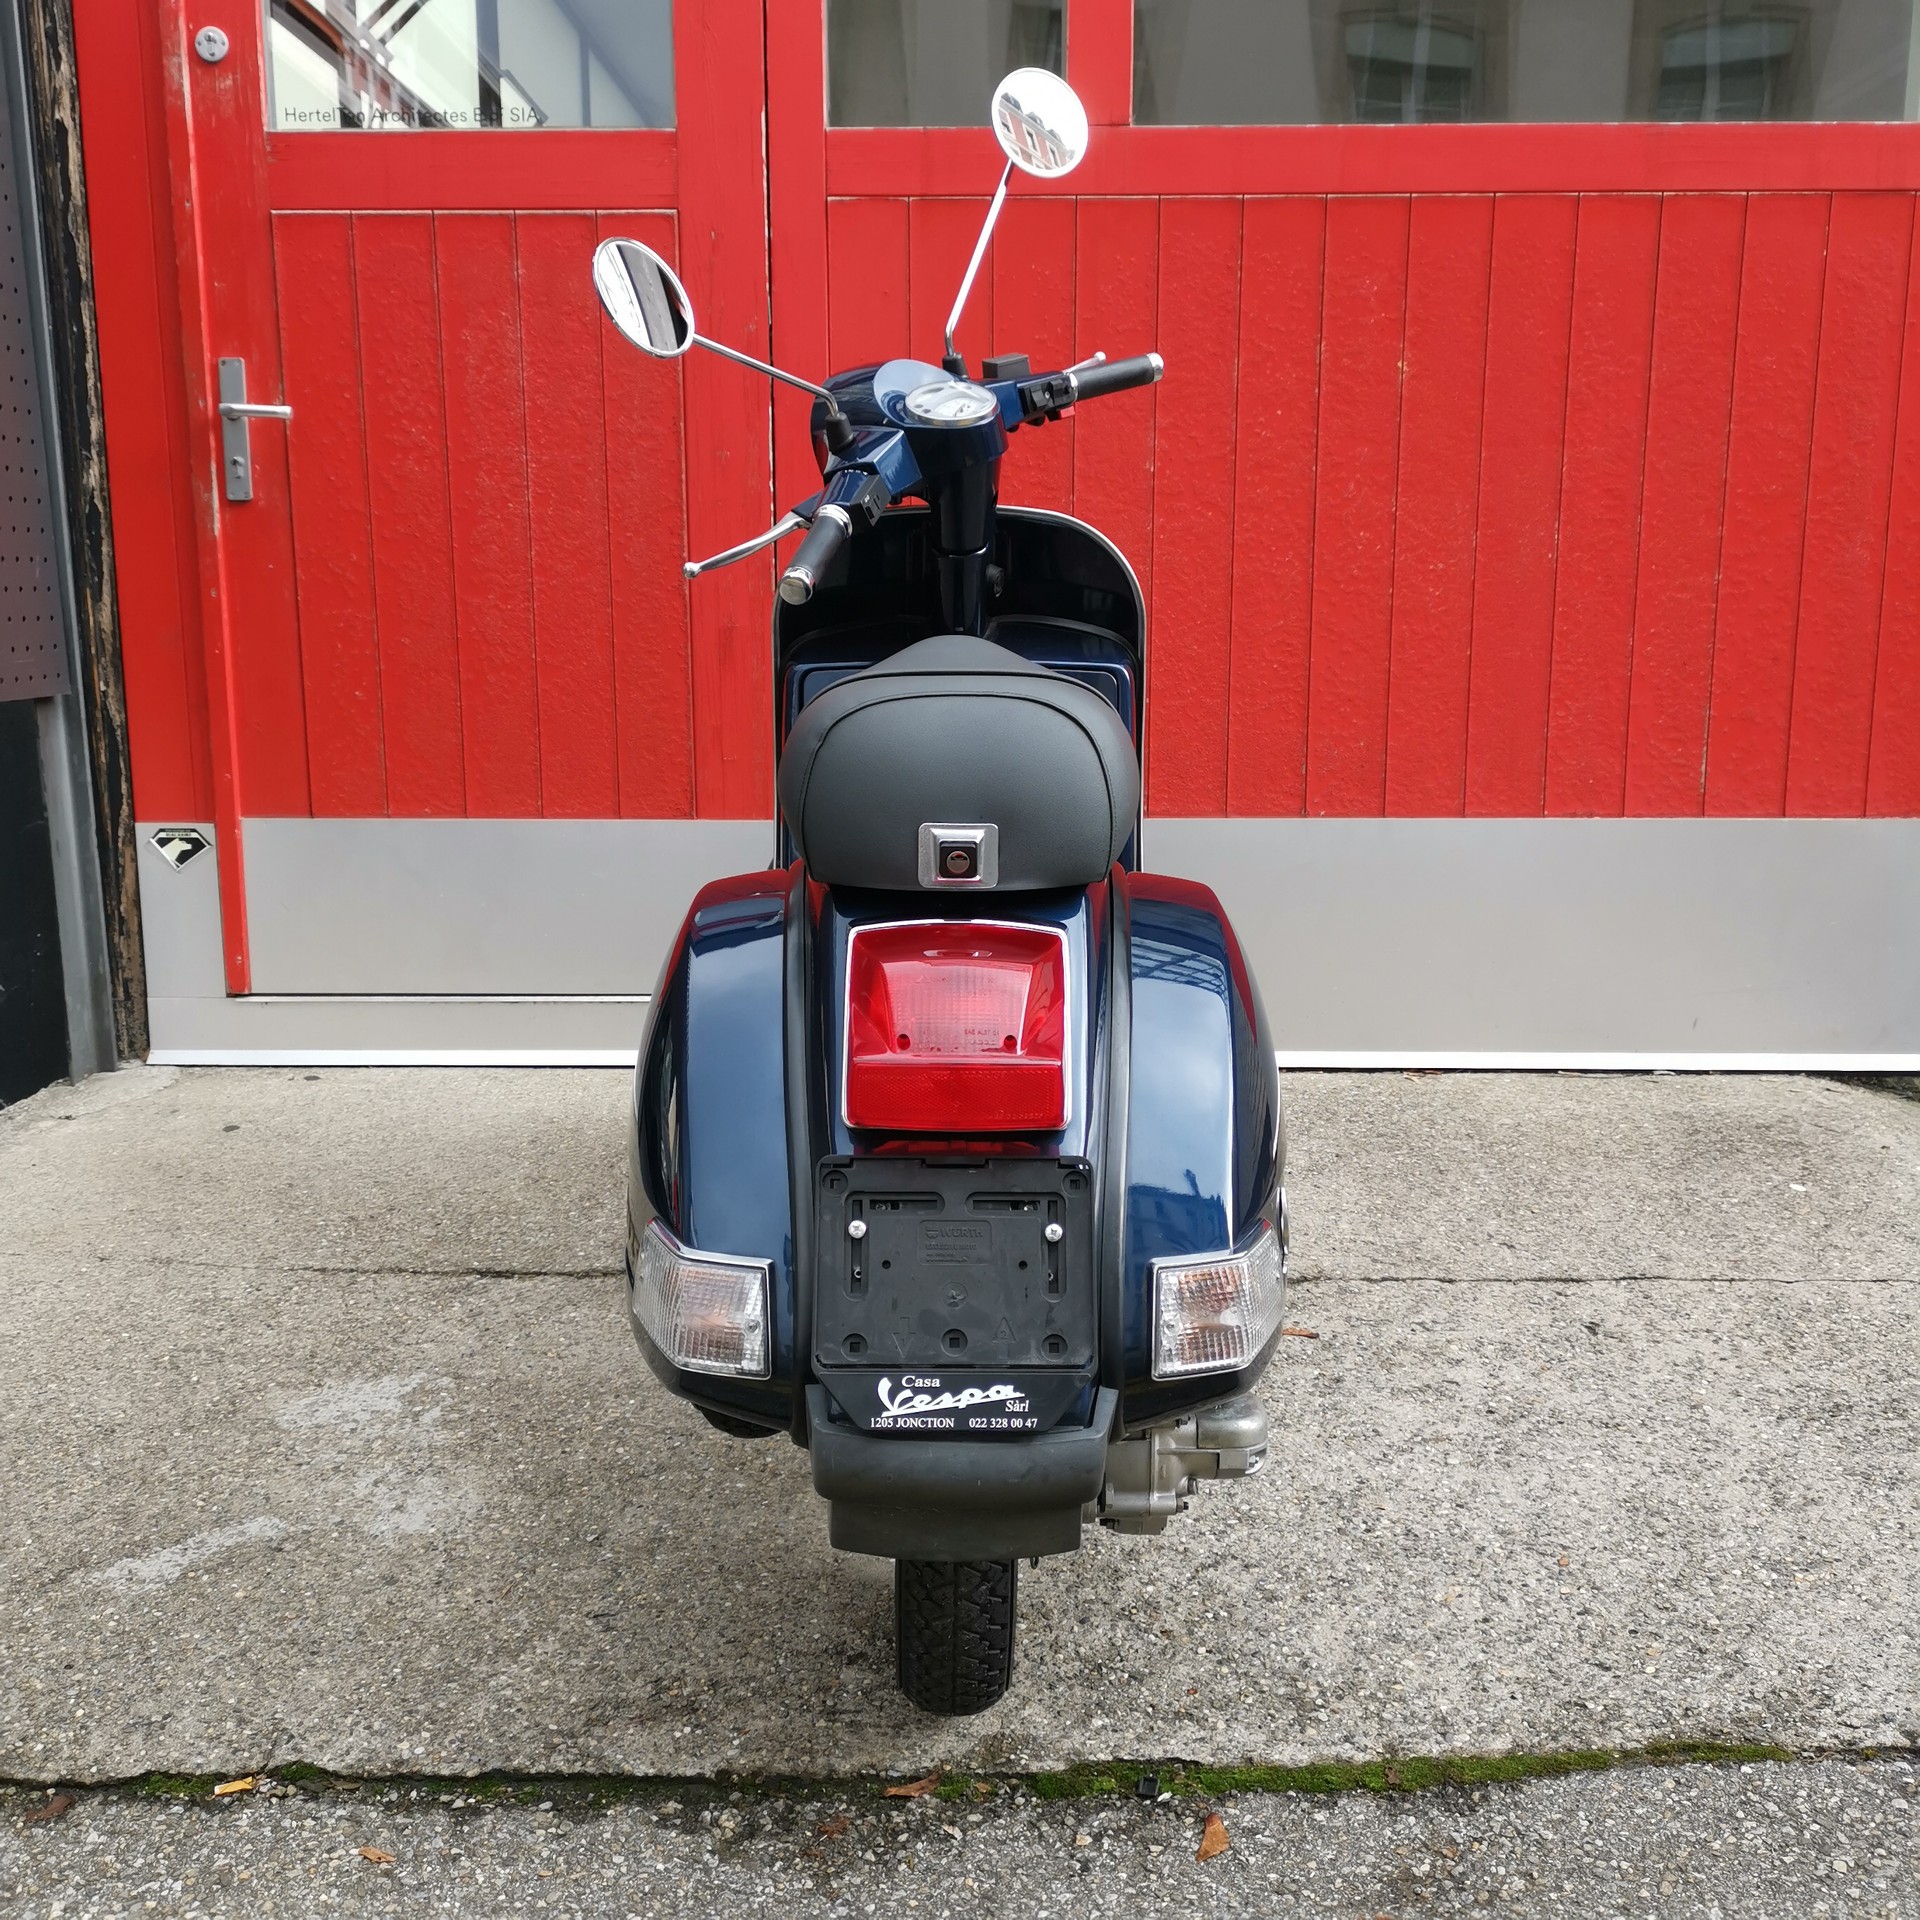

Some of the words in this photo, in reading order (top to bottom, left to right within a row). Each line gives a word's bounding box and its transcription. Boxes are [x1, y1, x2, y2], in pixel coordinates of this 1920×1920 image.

[371, 107, 468, 123] Architectes
[510, 107, 540, 122] SIA
[901, 1375, 941, 1388] Casa
[877, 1376, 1026, 1418] Vespa
[1005, 1400, 1029, 1413] Sàrl
[870, 1417, 894, 1428] 1205
[896, 1417, 955, 1428] JONCTION
[969, 1417, 988, 1428] 022
[990, 1417, 1008, 1428] 328
[1010, 1417, 1023, 1428] 00
[1025, 1417, 1038, 1428] 47
